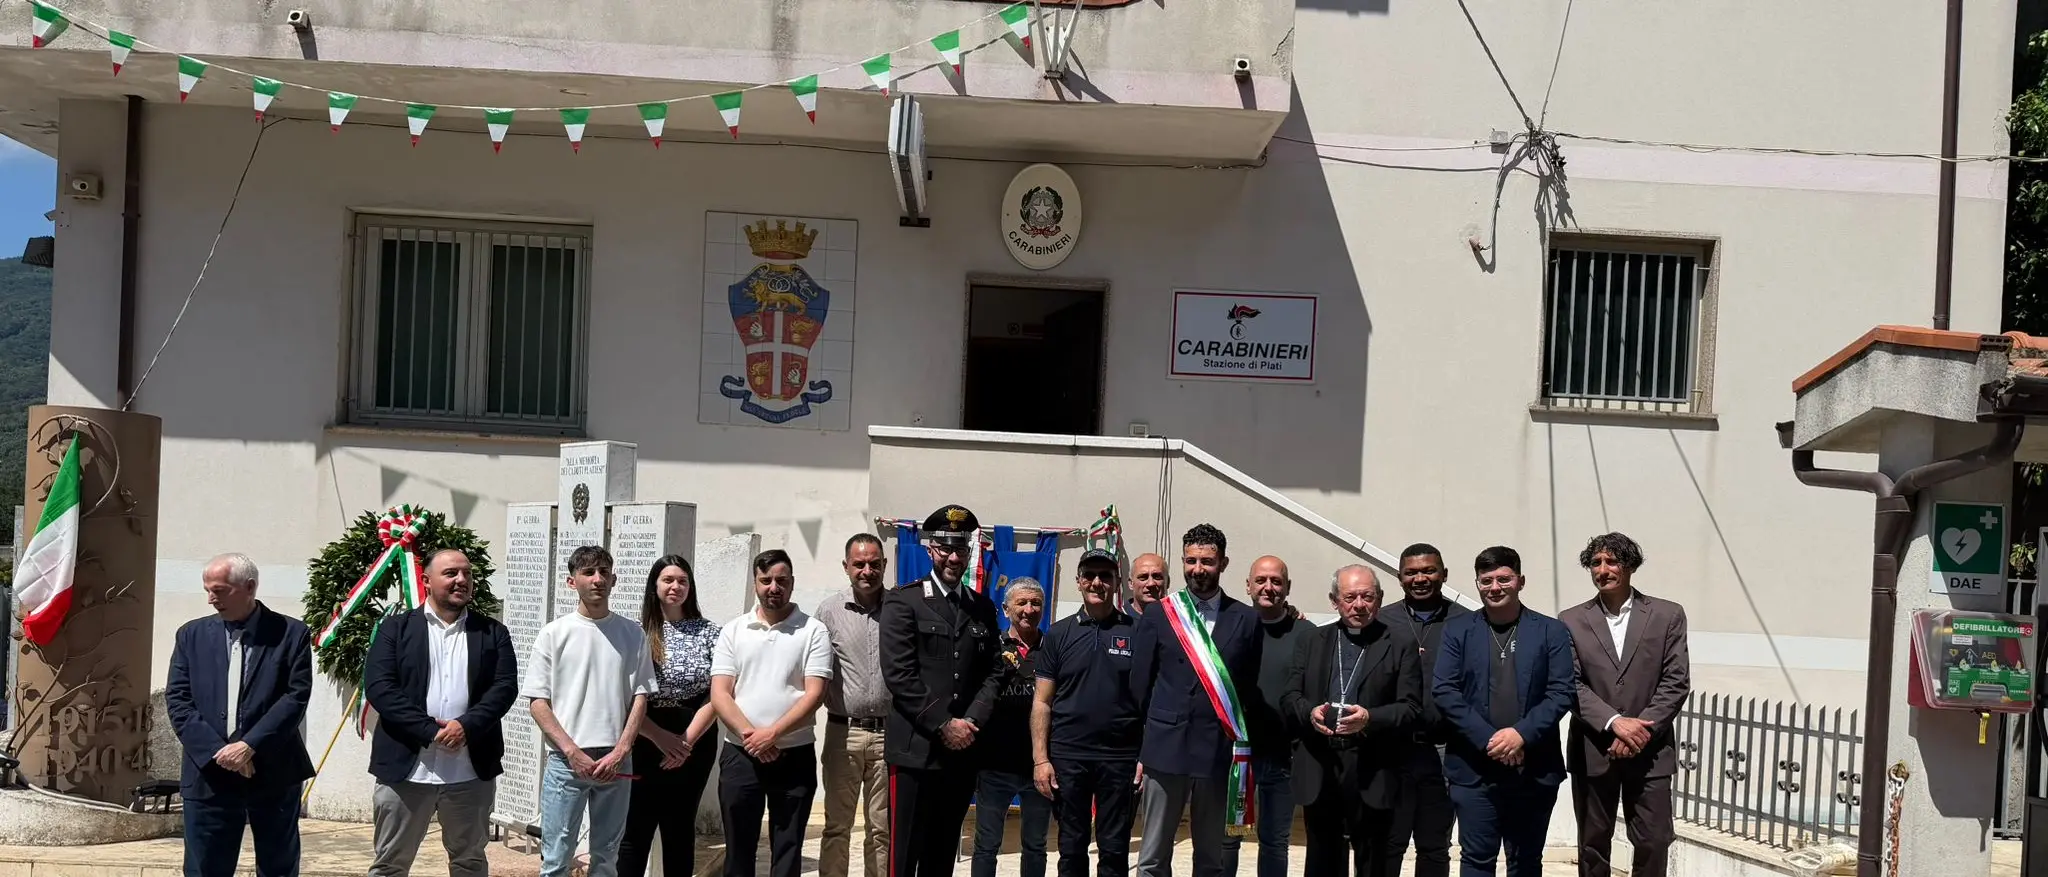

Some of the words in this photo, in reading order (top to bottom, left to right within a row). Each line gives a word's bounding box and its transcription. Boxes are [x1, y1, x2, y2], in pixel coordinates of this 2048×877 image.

[1009, 230, 1072, 255] CARABINIERI
[1178, 339, 1308, 360] CARABINIERI
[1203, 358, 1245, 369] Stazione
[1248, 361, 1258, 370] di
[1950, 577, 1981, 590] DAE
[1953, 622, 2024, 634] DEFIBRILLATORE
[1982, 652, 1996, 660] AED
